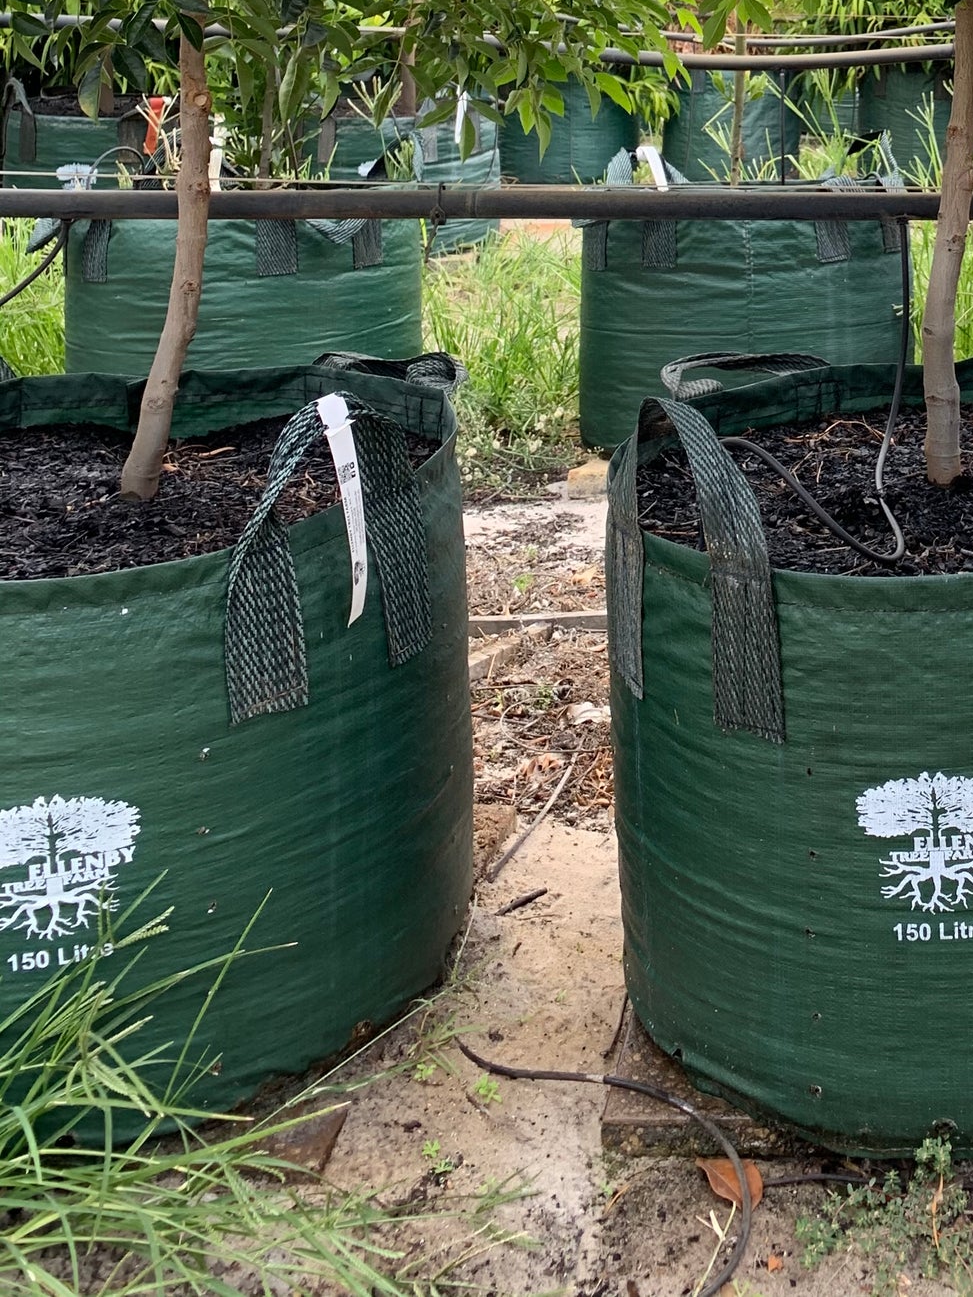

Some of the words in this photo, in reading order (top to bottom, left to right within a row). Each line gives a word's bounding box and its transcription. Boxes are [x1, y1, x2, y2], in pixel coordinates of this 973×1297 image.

[29, 846, 136, 879] ELLENBY
[889, 851, 929, 862] TREE
[2, 879, 47, 895] TREE
[62, 867, 110, 886] FARM
[893, 923, 931, 941] 150
[7, 950, 50, 972] 150
[57, 942, 114, 966] Lite
